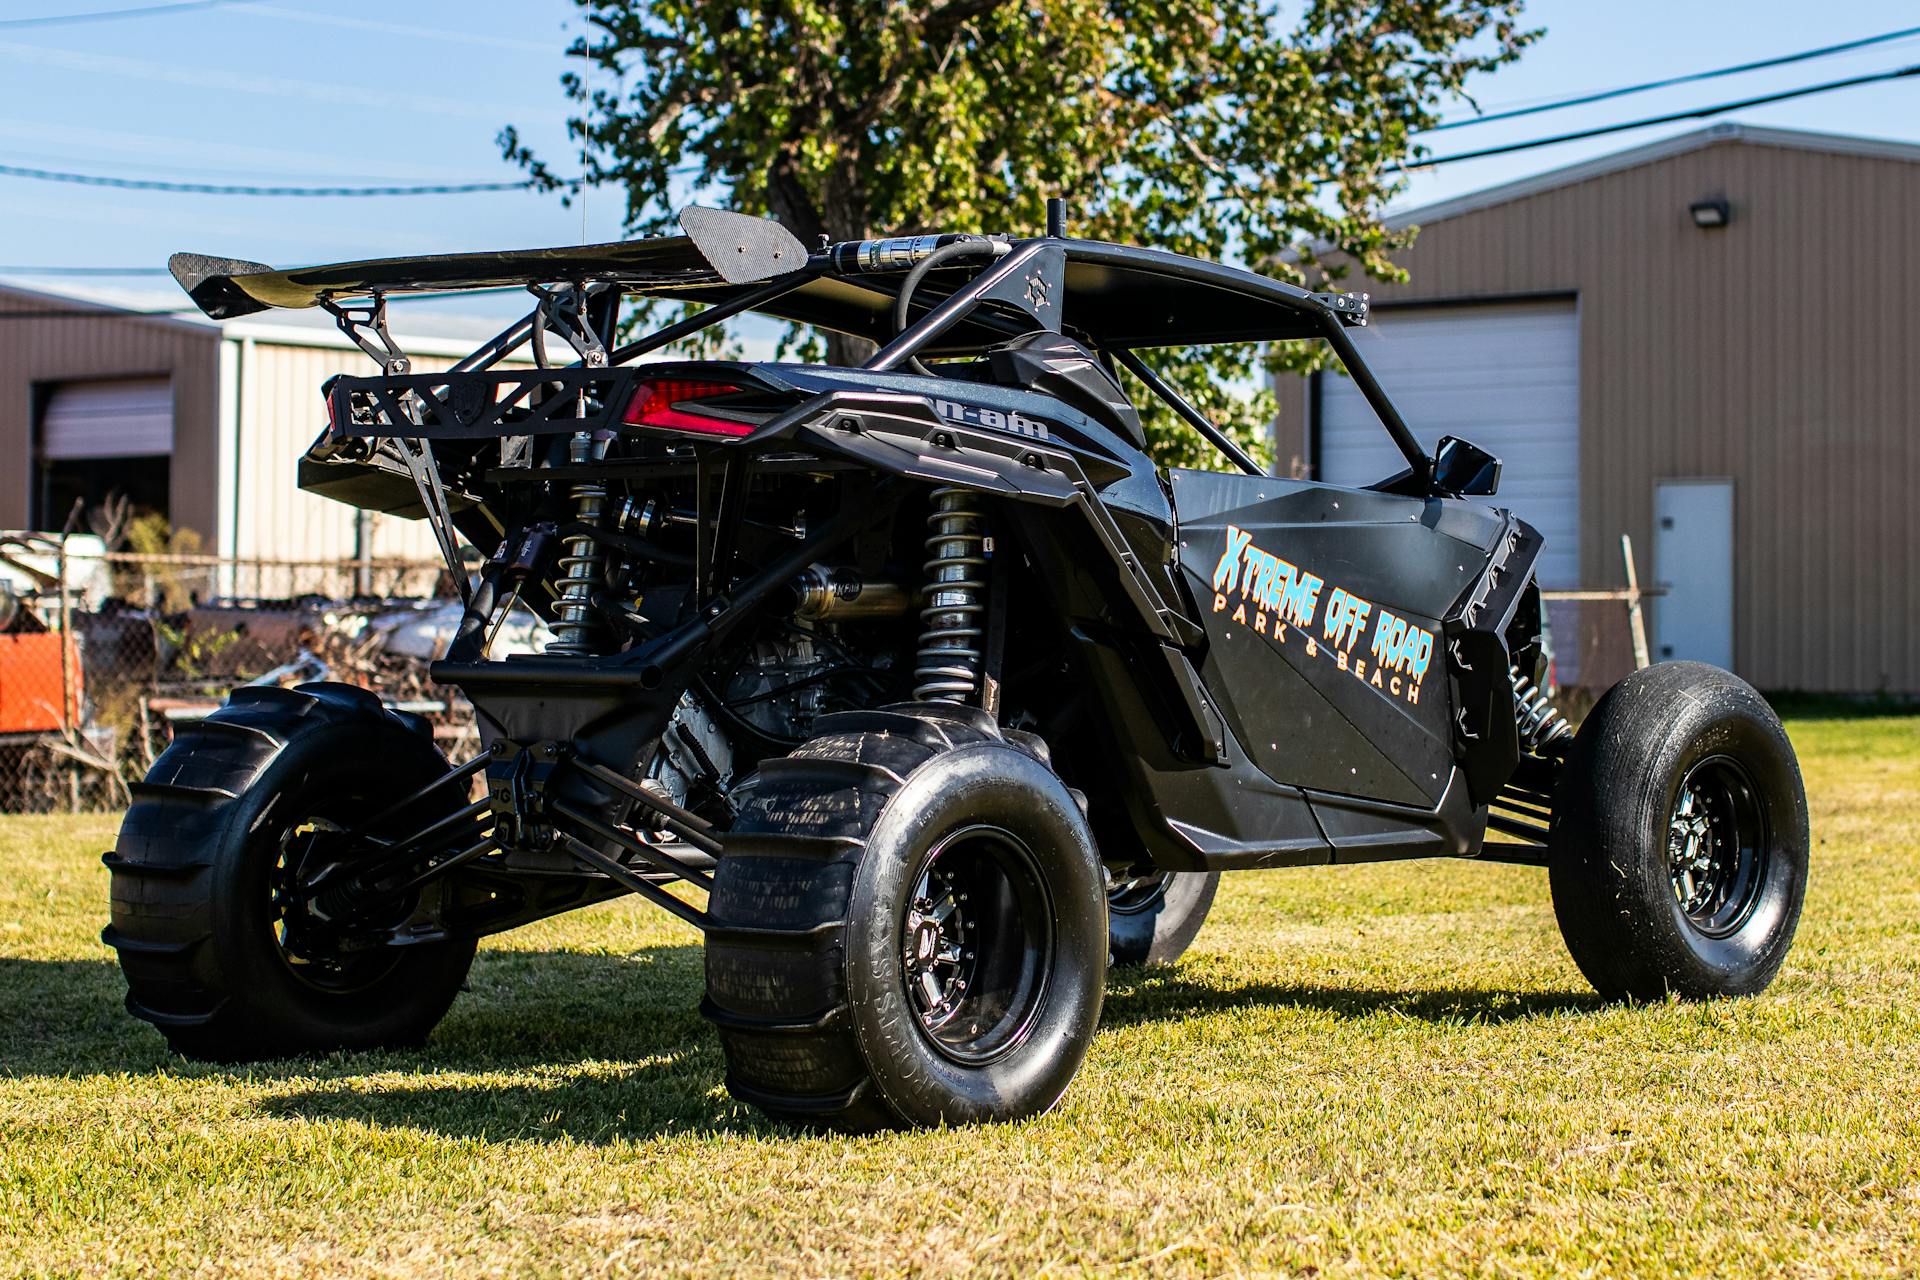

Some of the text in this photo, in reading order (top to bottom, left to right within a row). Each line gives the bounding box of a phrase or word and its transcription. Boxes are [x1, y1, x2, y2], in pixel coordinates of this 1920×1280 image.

[926, 397, 1049, 440] n-am
[1213, 525, 1434, 687] XTREME OFF ROAD
[1213, 593, 1420, 705] PARK & BEACH
